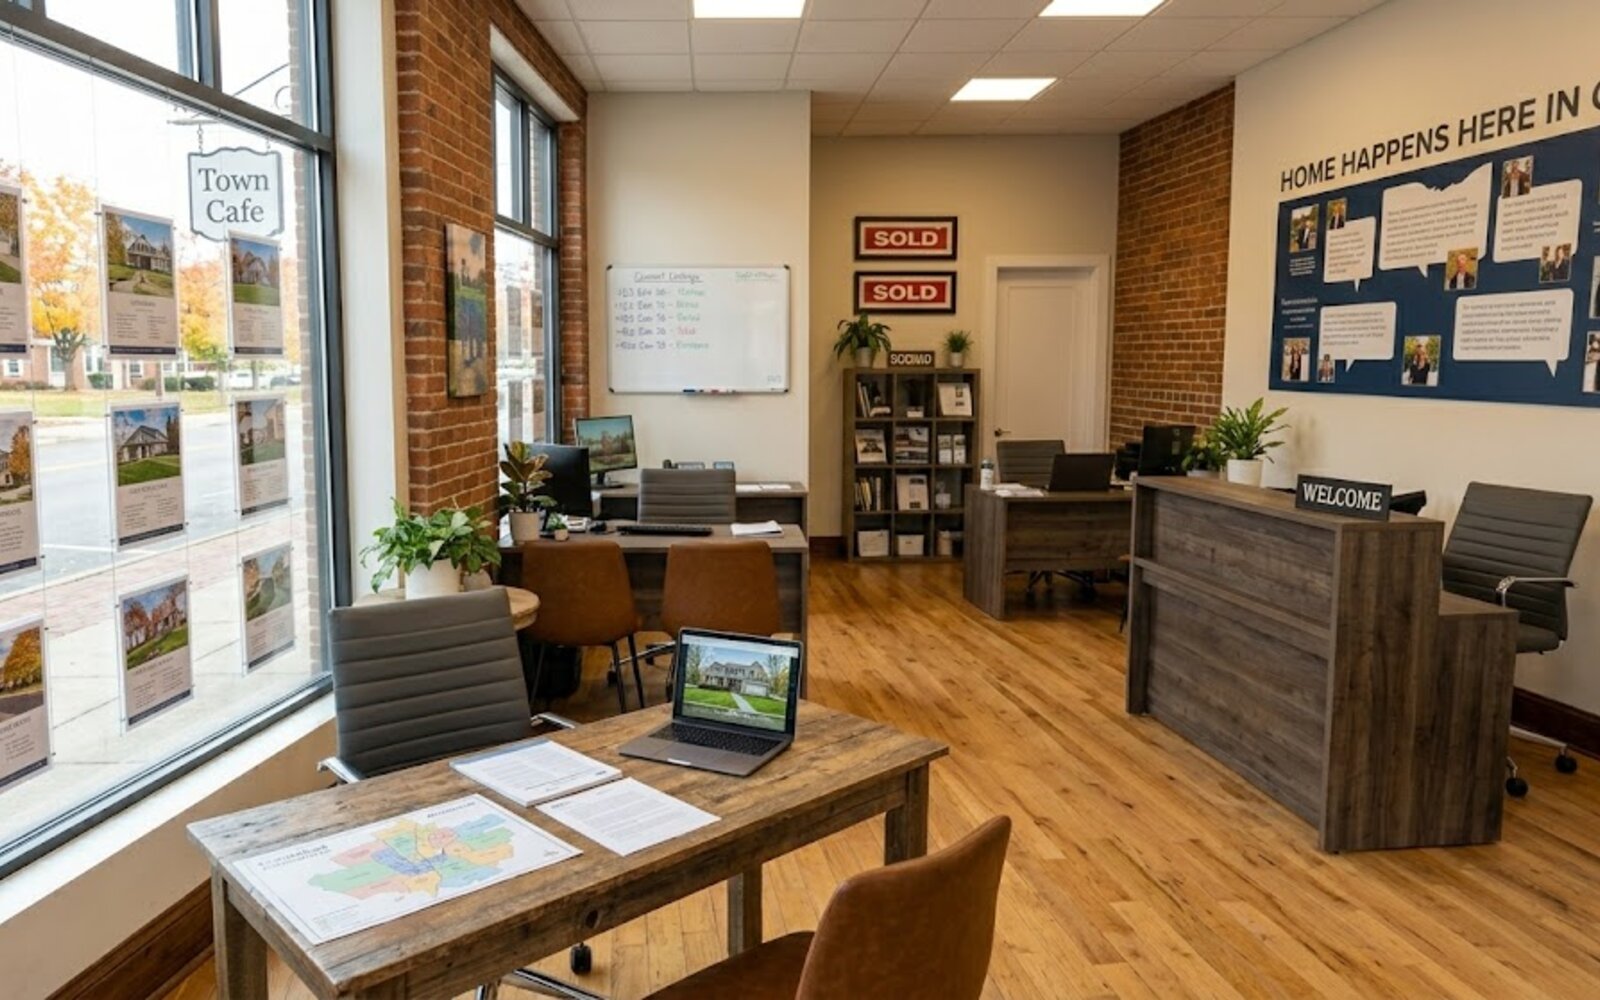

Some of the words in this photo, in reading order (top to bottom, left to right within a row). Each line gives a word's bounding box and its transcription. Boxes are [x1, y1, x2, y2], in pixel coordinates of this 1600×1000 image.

[1280, 156, 1337, 192] HOME
[1341, 124, 1449, 176] HAPPENS
[1458, 98, 1537, 147] HERE
[1546, 85, 1581, 125] IN
[198, 167, 270, 192] Town
[206, 198, 265, 224] Cafe
[873, 230, 939, 247] SOLD
[872, 284, 938, 301] SOLD
[1302, 482, 1383, 511] WELCOME
